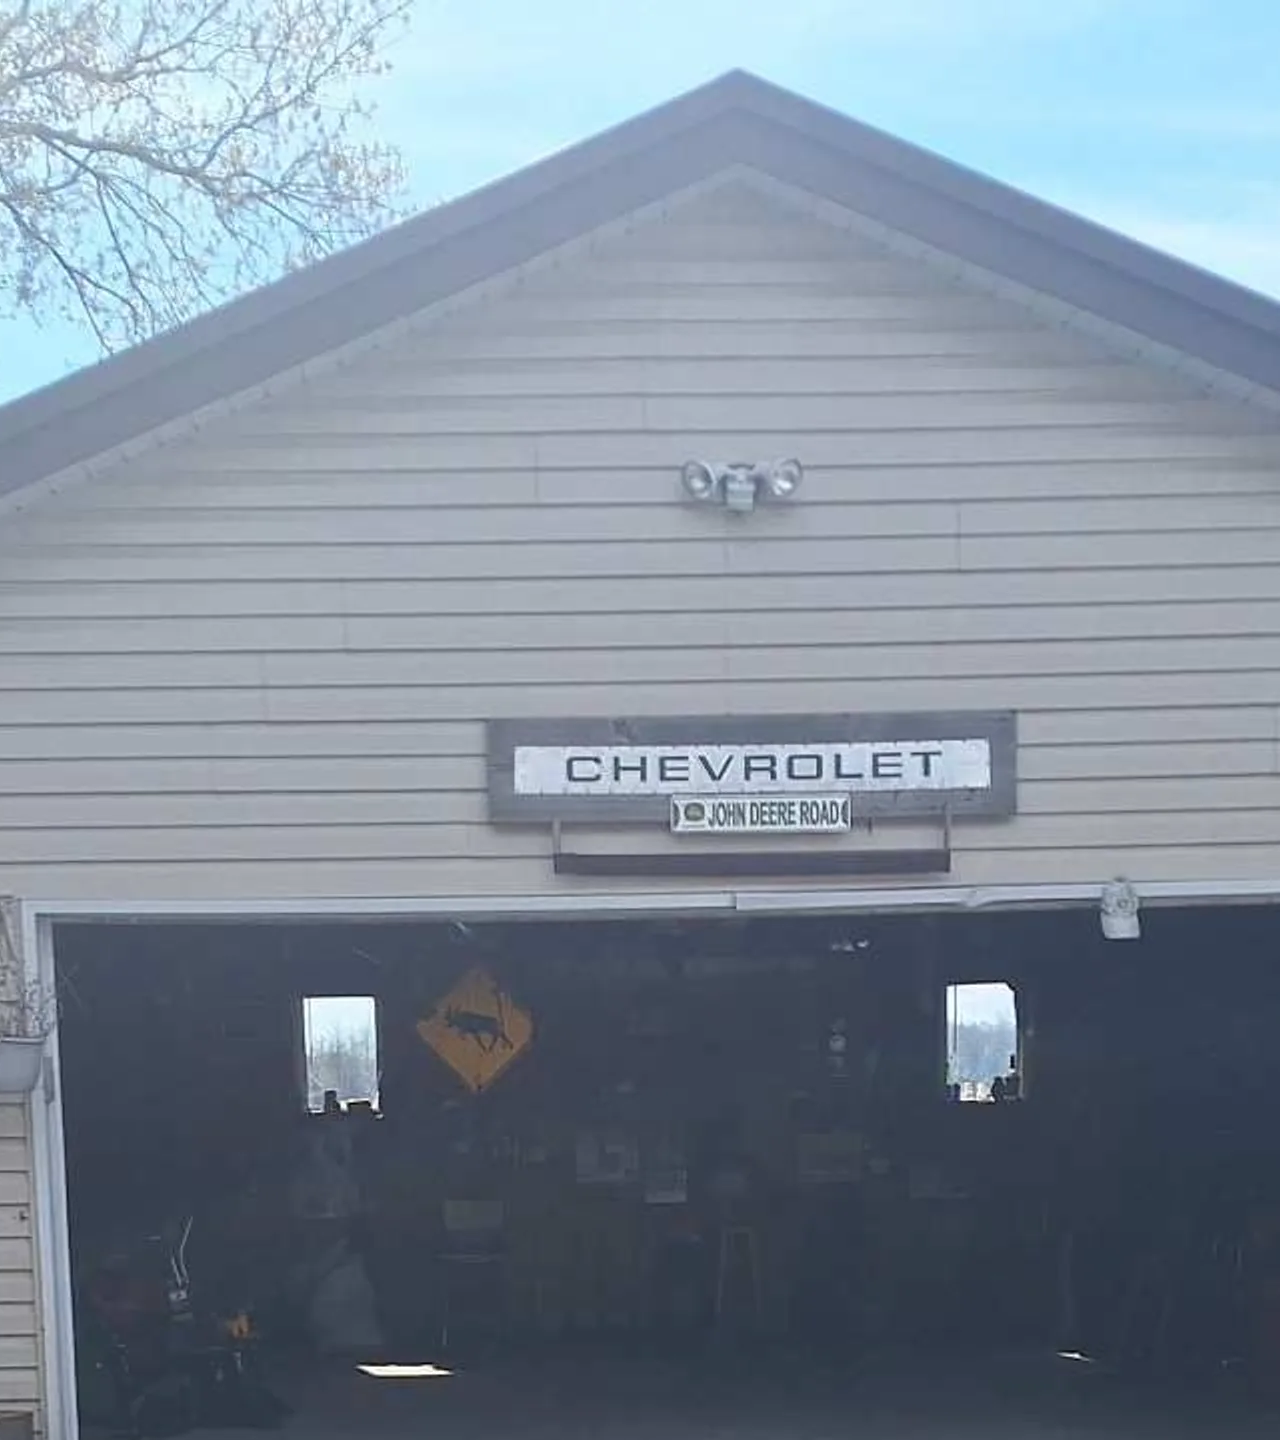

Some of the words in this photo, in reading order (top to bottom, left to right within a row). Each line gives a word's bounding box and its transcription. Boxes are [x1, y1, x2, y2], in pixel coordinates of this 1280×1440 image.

[565, 750, 943, 782] CHEVROLET
[707, 800, 746, 828] JOHN
[749, 800, 797, 826] DEERE
[799, 799, 840, 826] ROAD
